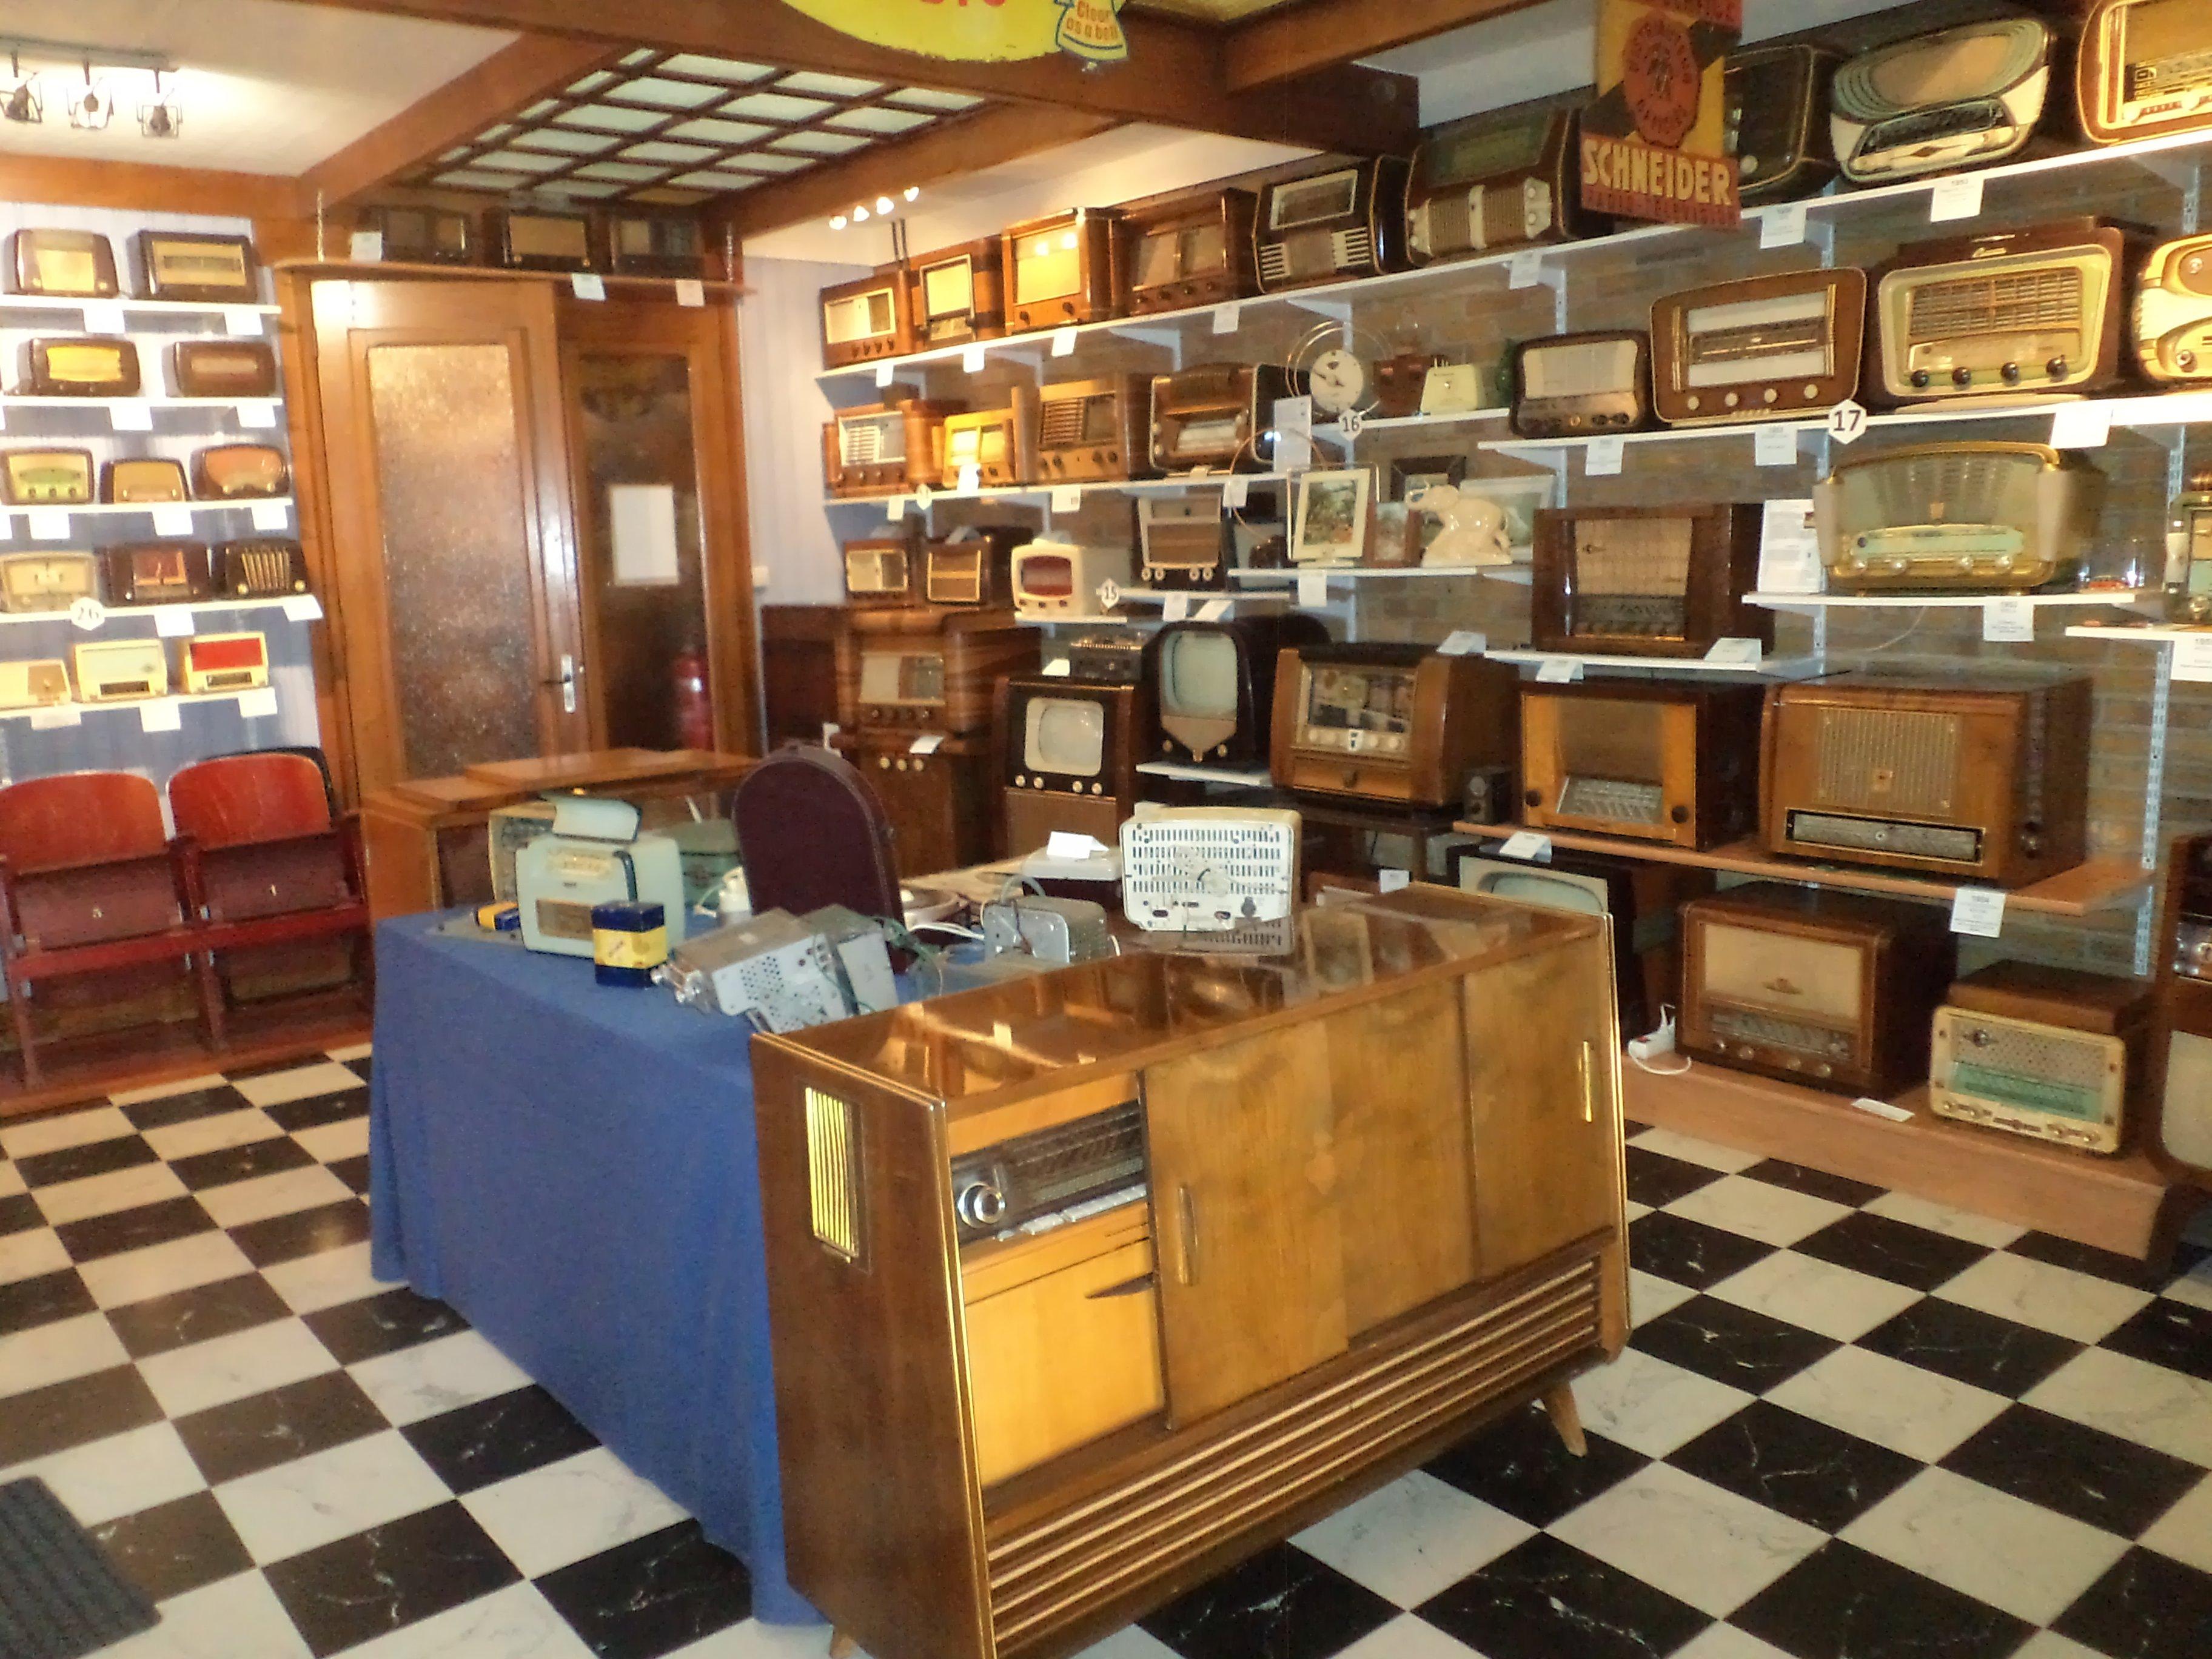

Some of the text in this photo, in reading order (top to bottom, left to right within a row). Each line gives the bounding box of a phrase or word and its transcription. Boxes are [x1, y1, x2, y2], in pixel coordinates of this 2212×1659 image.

[1583, 138, 1732, 206] SCHNEIDER
[1342, 416, 1359, 432] 16
[1833, 409, 1862, 432] 17
[1105, 586, 1117, 600] 15
